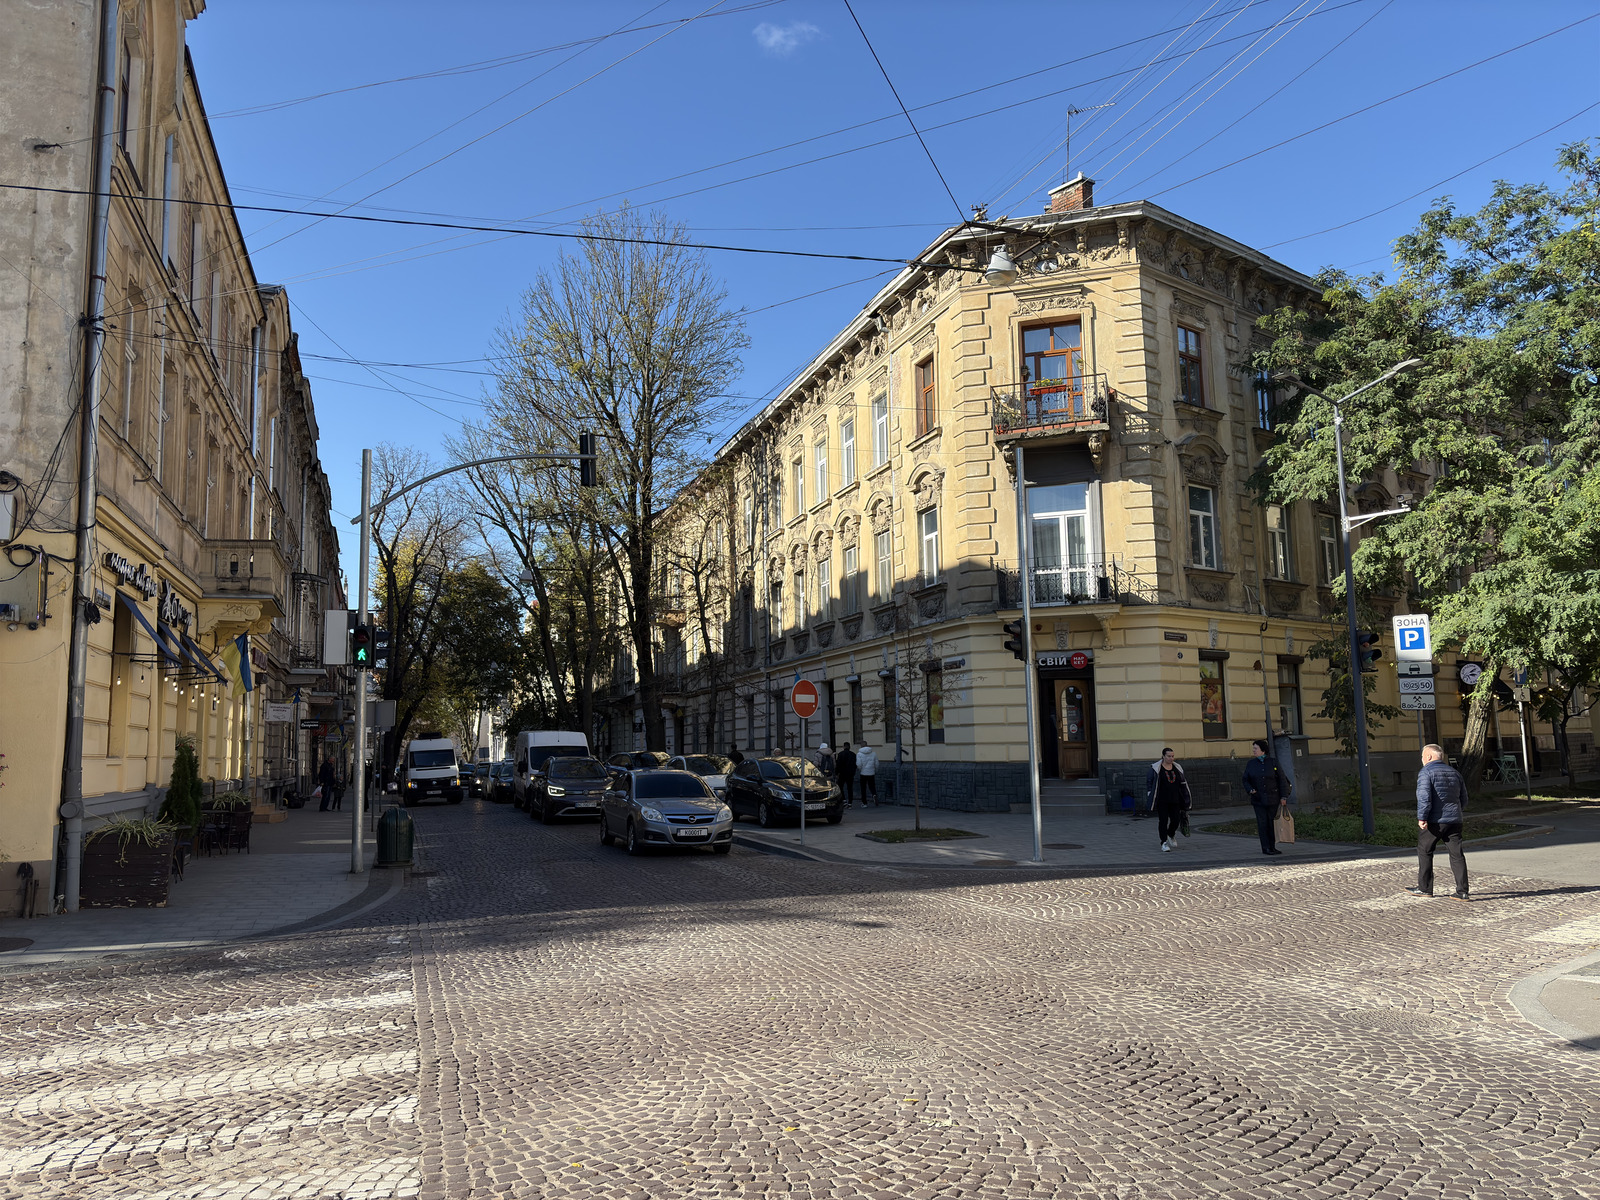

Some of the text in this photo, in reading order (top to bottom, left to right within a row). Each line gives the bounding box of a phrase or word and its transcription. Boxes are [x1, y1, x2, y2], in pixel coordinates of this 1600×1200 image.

[1397, 618, 1425, 627] ЗОНА
[1404, 630, 1419, 647] P
[1038, 655, 1067, 666] СВІЙ
